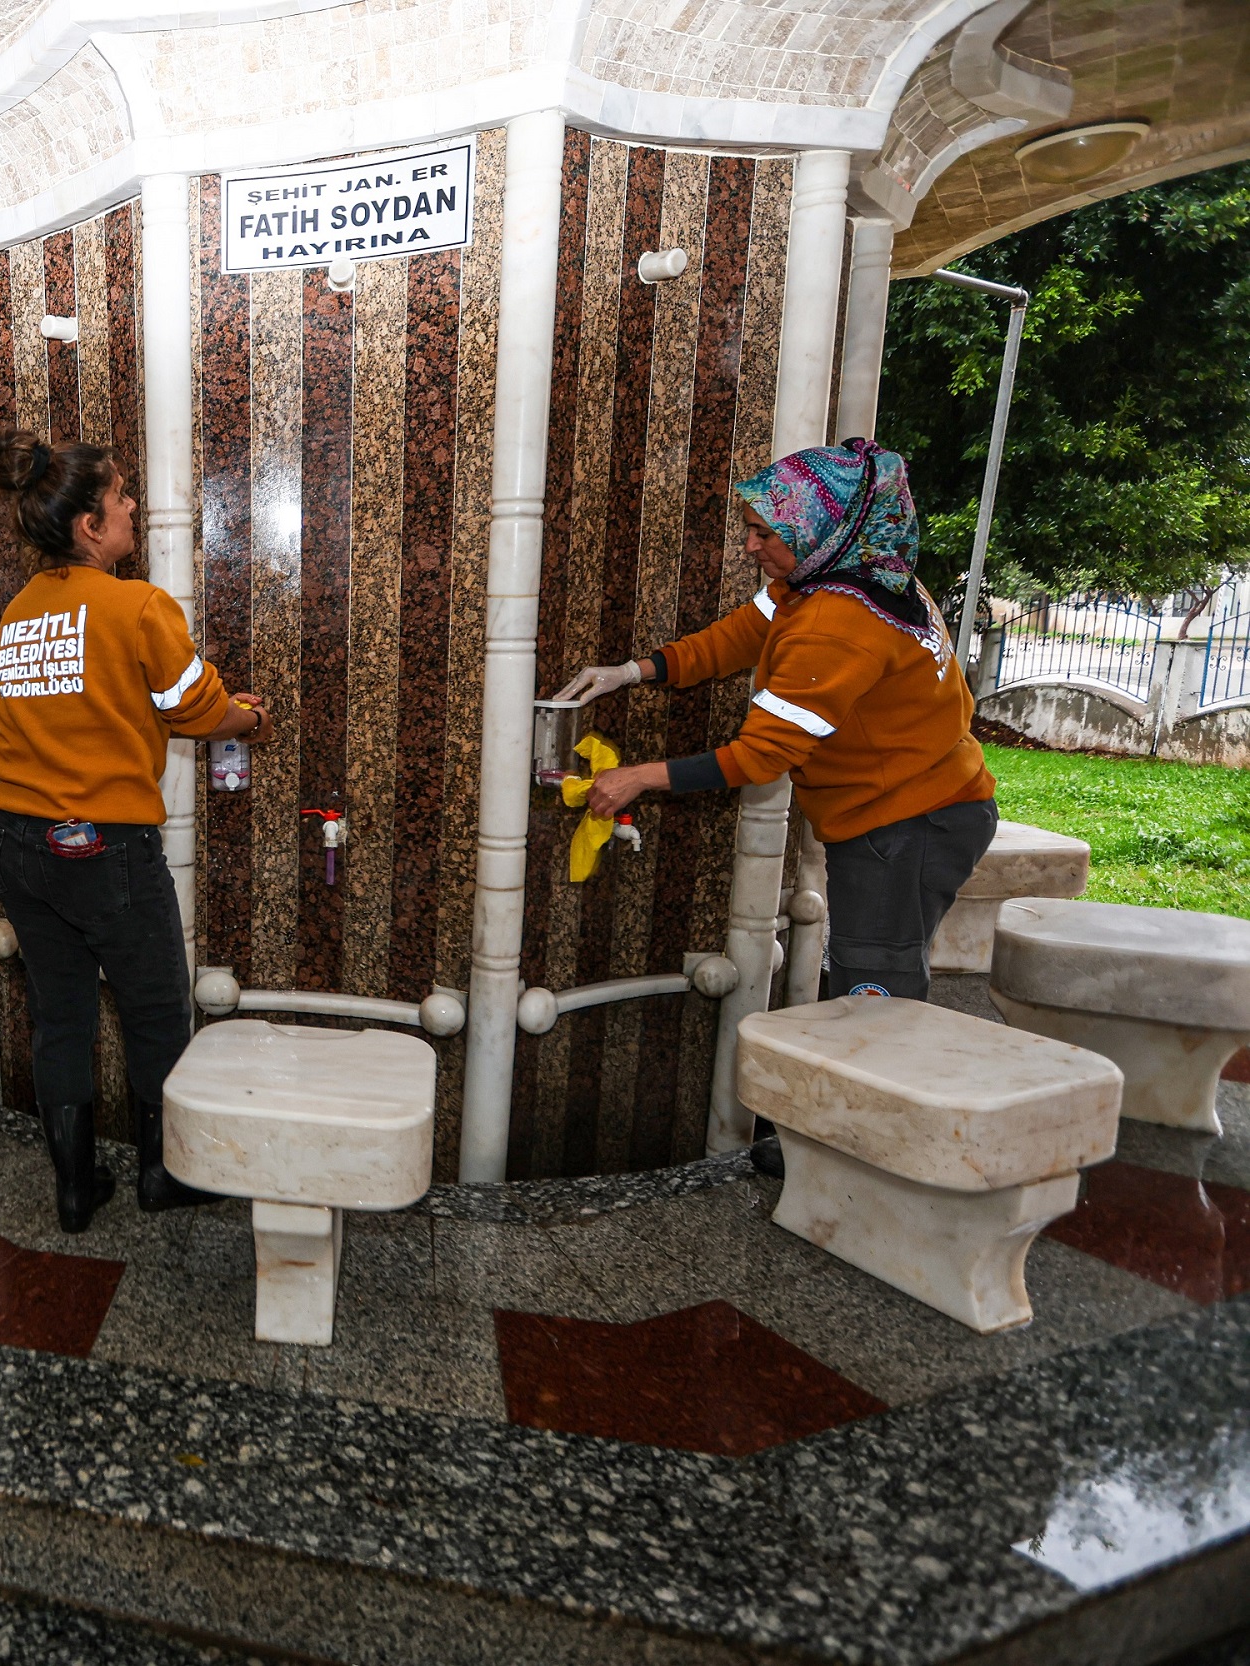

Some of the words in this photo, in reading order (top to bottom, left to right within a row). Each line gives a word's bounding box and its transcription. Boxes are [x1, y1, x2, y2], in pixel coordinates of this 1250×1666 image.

[247, 183, 327, 206] ŞEHİT
[338, 173, 401, 194] JAN.
[411, 163, 448, 182] ER
[240, 204, 319, 239] FATİH
[330, 186, 456, 230] SOYDAN
[262, 227, 431, 260] HAYIRINA
[0, 603, 87, 648] MEZİTLİ
[43, 657, 84, 680] İŞLERİ
